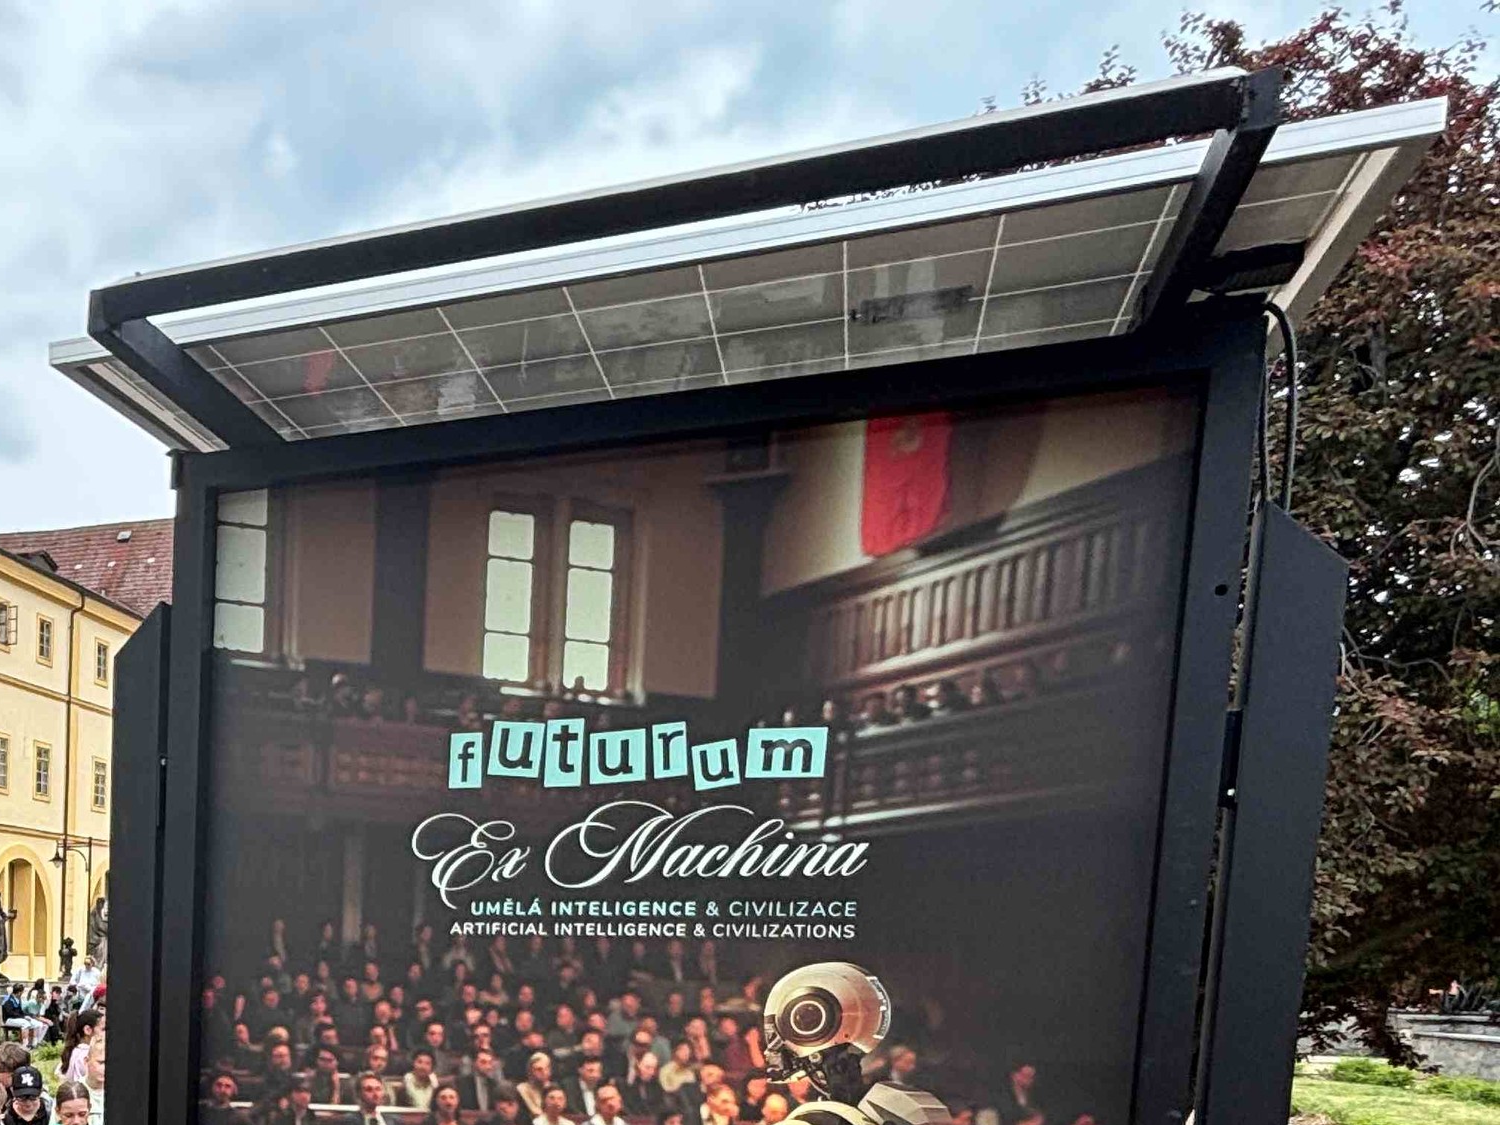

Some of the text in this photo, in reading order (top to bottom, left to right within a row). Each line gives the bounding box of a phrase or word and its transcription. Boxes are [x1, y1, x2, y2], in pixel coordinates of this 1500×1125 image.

[457, 723, 813, 784] futurum
[412, 801, 870, 909] Ex Machina
[470, 897, 858, 918] UMĚLÁ INTELIGENCE & CIVILIZACE
[449, 921, 856, 939] ARTIFICIAL INTELLIGENCE & CIVILIZATIONS
